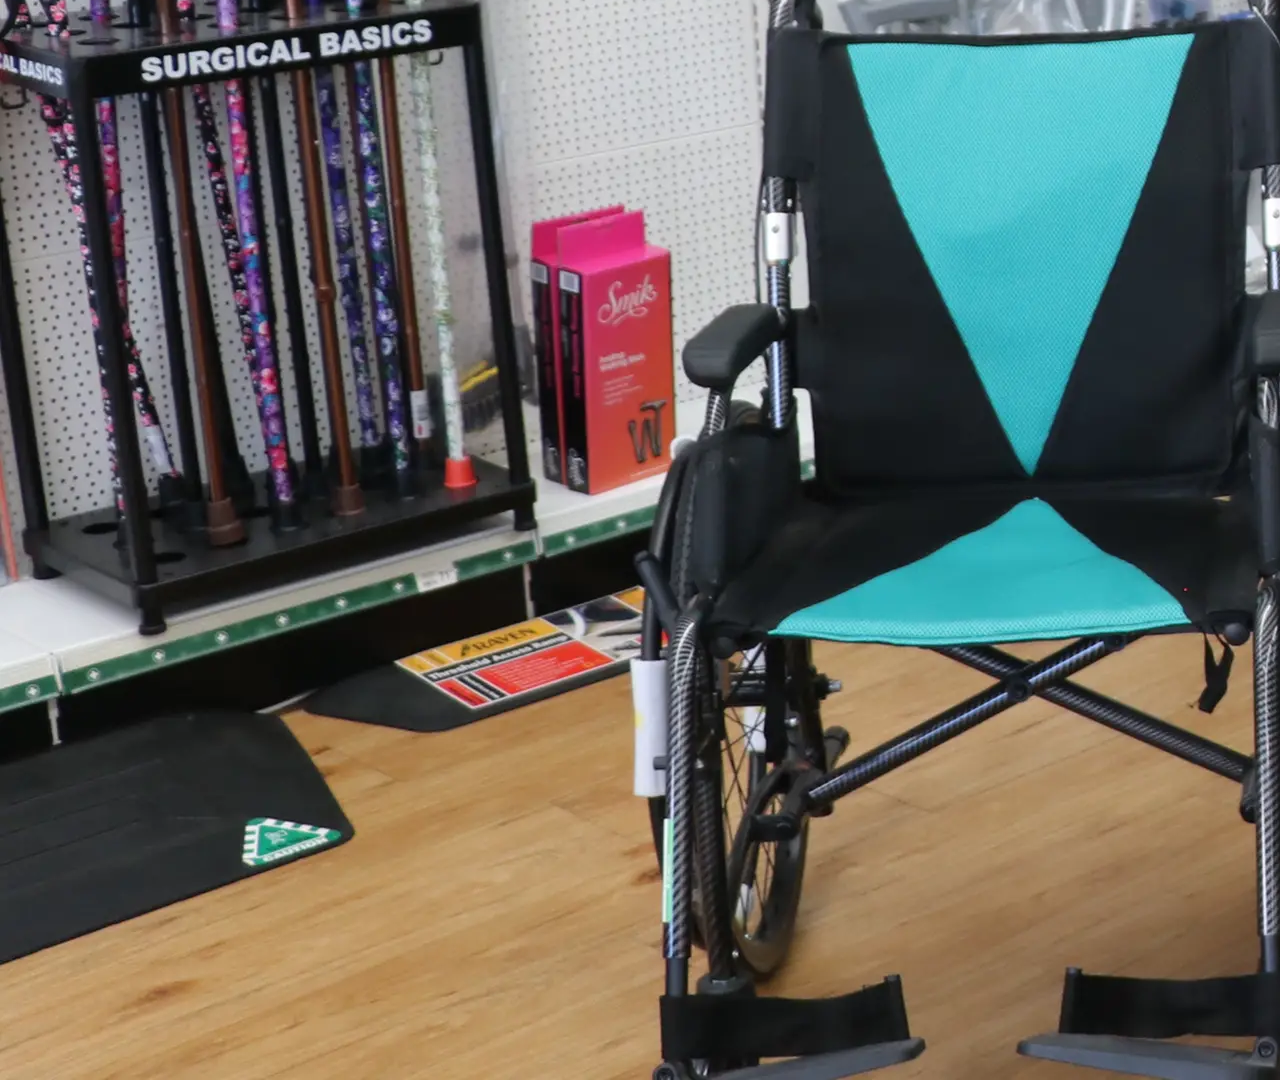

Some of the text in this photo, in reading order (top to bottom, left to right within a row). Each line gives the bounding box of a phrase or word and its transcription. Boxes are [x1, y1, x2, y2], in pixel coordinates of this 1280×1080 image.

[141, 19, 432, 83] SURGICAL BASICS
[19, 58, 63, 86] BASICS
[597, 273, 659, 327] Smik
[470, 628, 537, 651] RAVEN
[428, 658, 491, 680] Threshold
